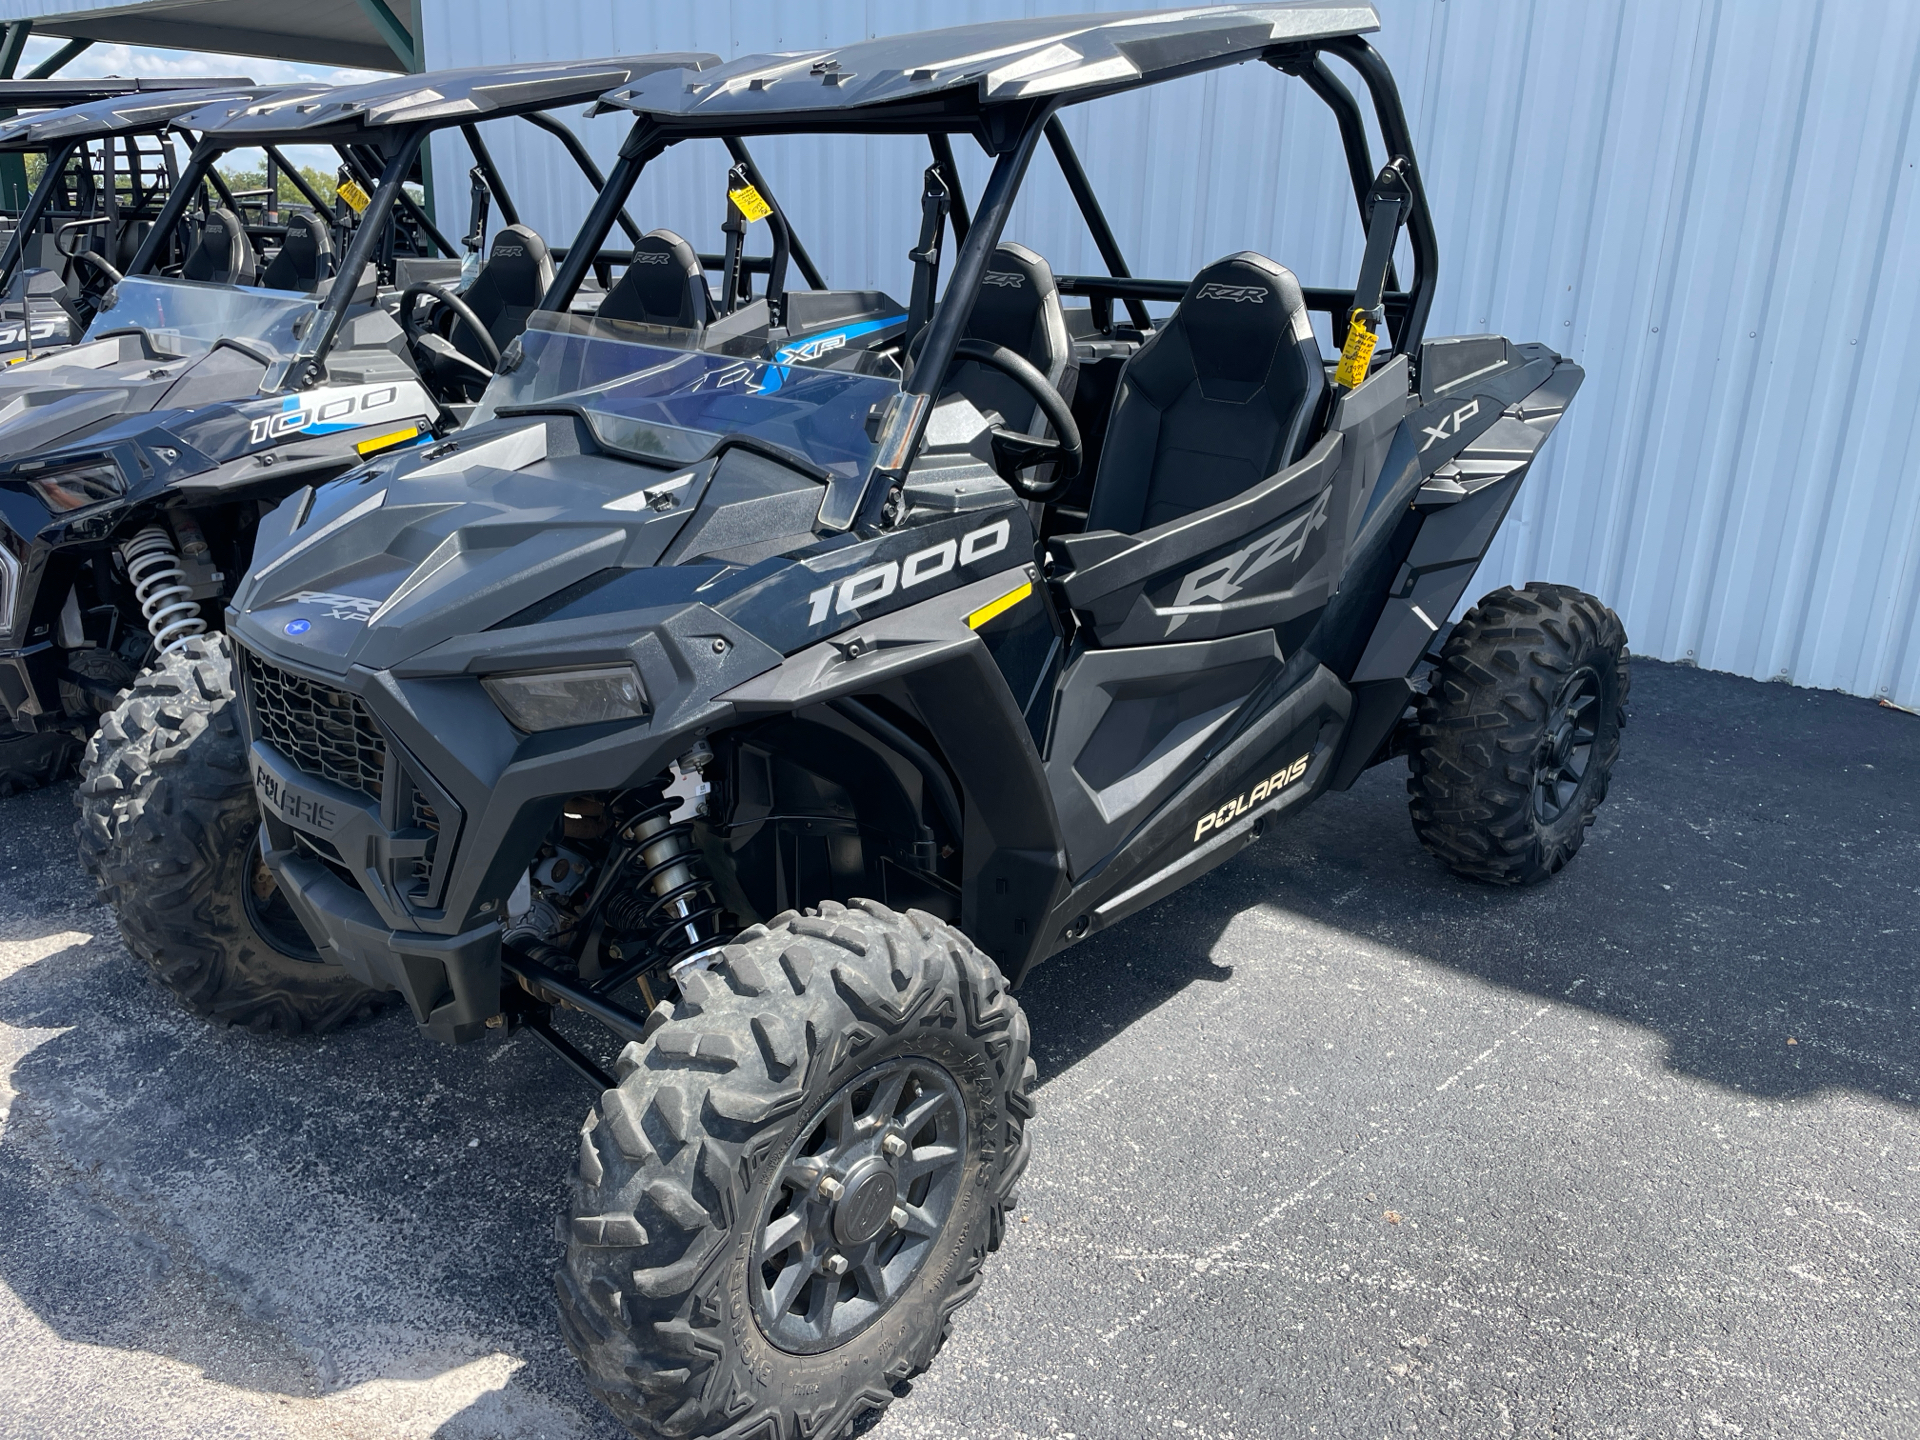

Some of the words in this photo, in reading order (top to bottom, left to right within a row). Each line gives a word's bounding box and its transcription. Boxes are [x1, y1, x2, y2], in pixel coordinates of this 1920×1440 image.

[491, 245, 524, 257] RZR
[633, 251, 671, 264] RZR
[981, 269, 1026, 288] ZR
[1195, 282, 1269, 304] RZR
[780, 333, 847, 366] XP
[250, 386, 399, 445] 1000
[1418, 399, 1480, 454] XP
[808, 518, 1011, 627] 1000
[1164, 483, 1333, 638] RZR
[274, 590, 384, 614] RZR
[320, 608, 371, 622] XP
[256, 765, 337, 831] POLARIS
[1193, 751, 1310, 842] POLARIS
